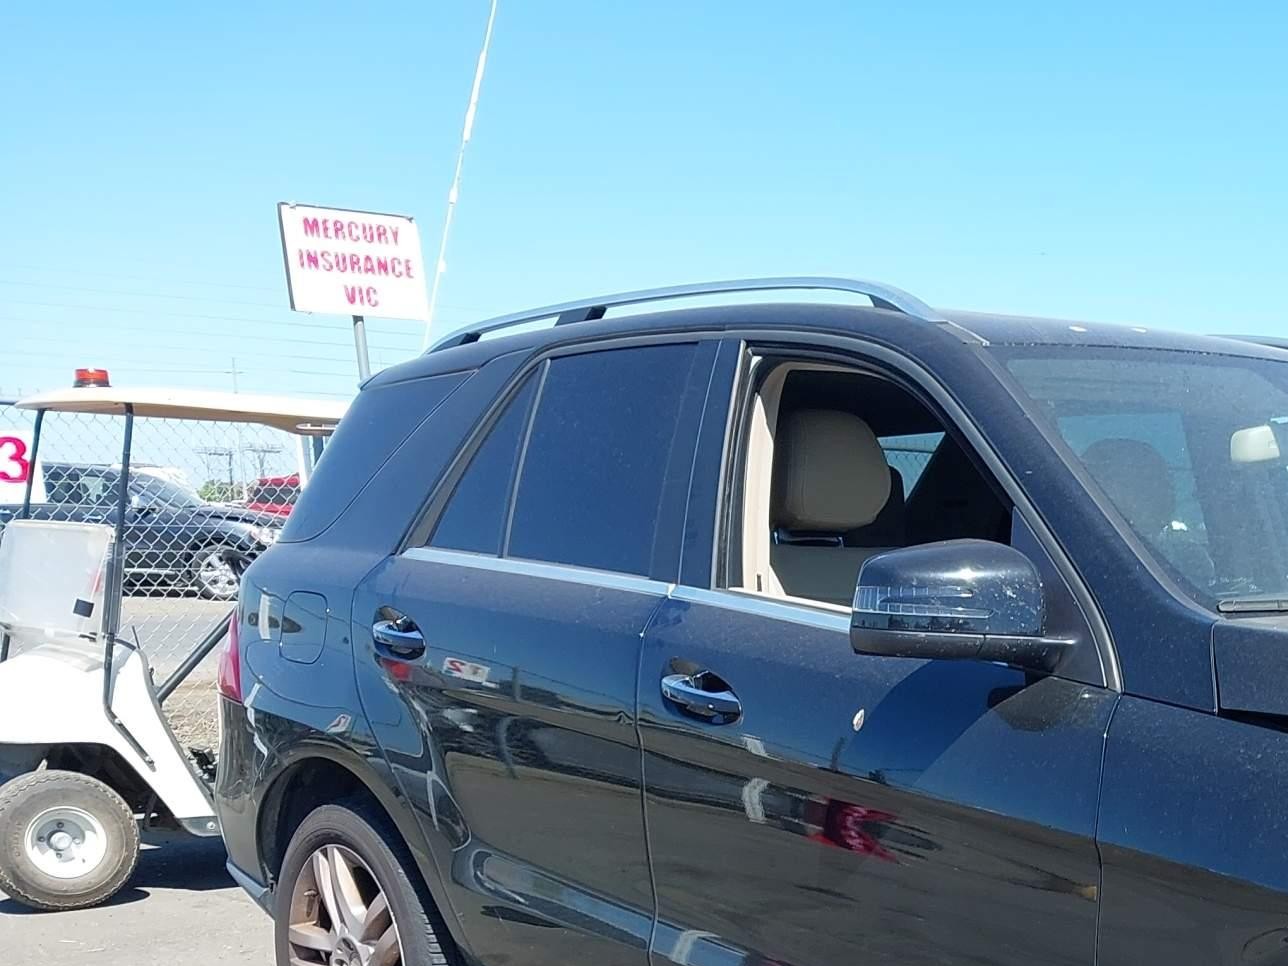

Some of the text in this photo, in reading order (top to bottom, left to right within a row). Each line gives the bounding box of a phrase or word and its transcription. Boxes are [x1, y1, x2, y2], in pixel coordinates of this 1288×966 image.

[303, 216, 400, 246] MERCURY
[298, 249, 414, 279] INSURANCE
[344, 285, 379, 308] VIC
